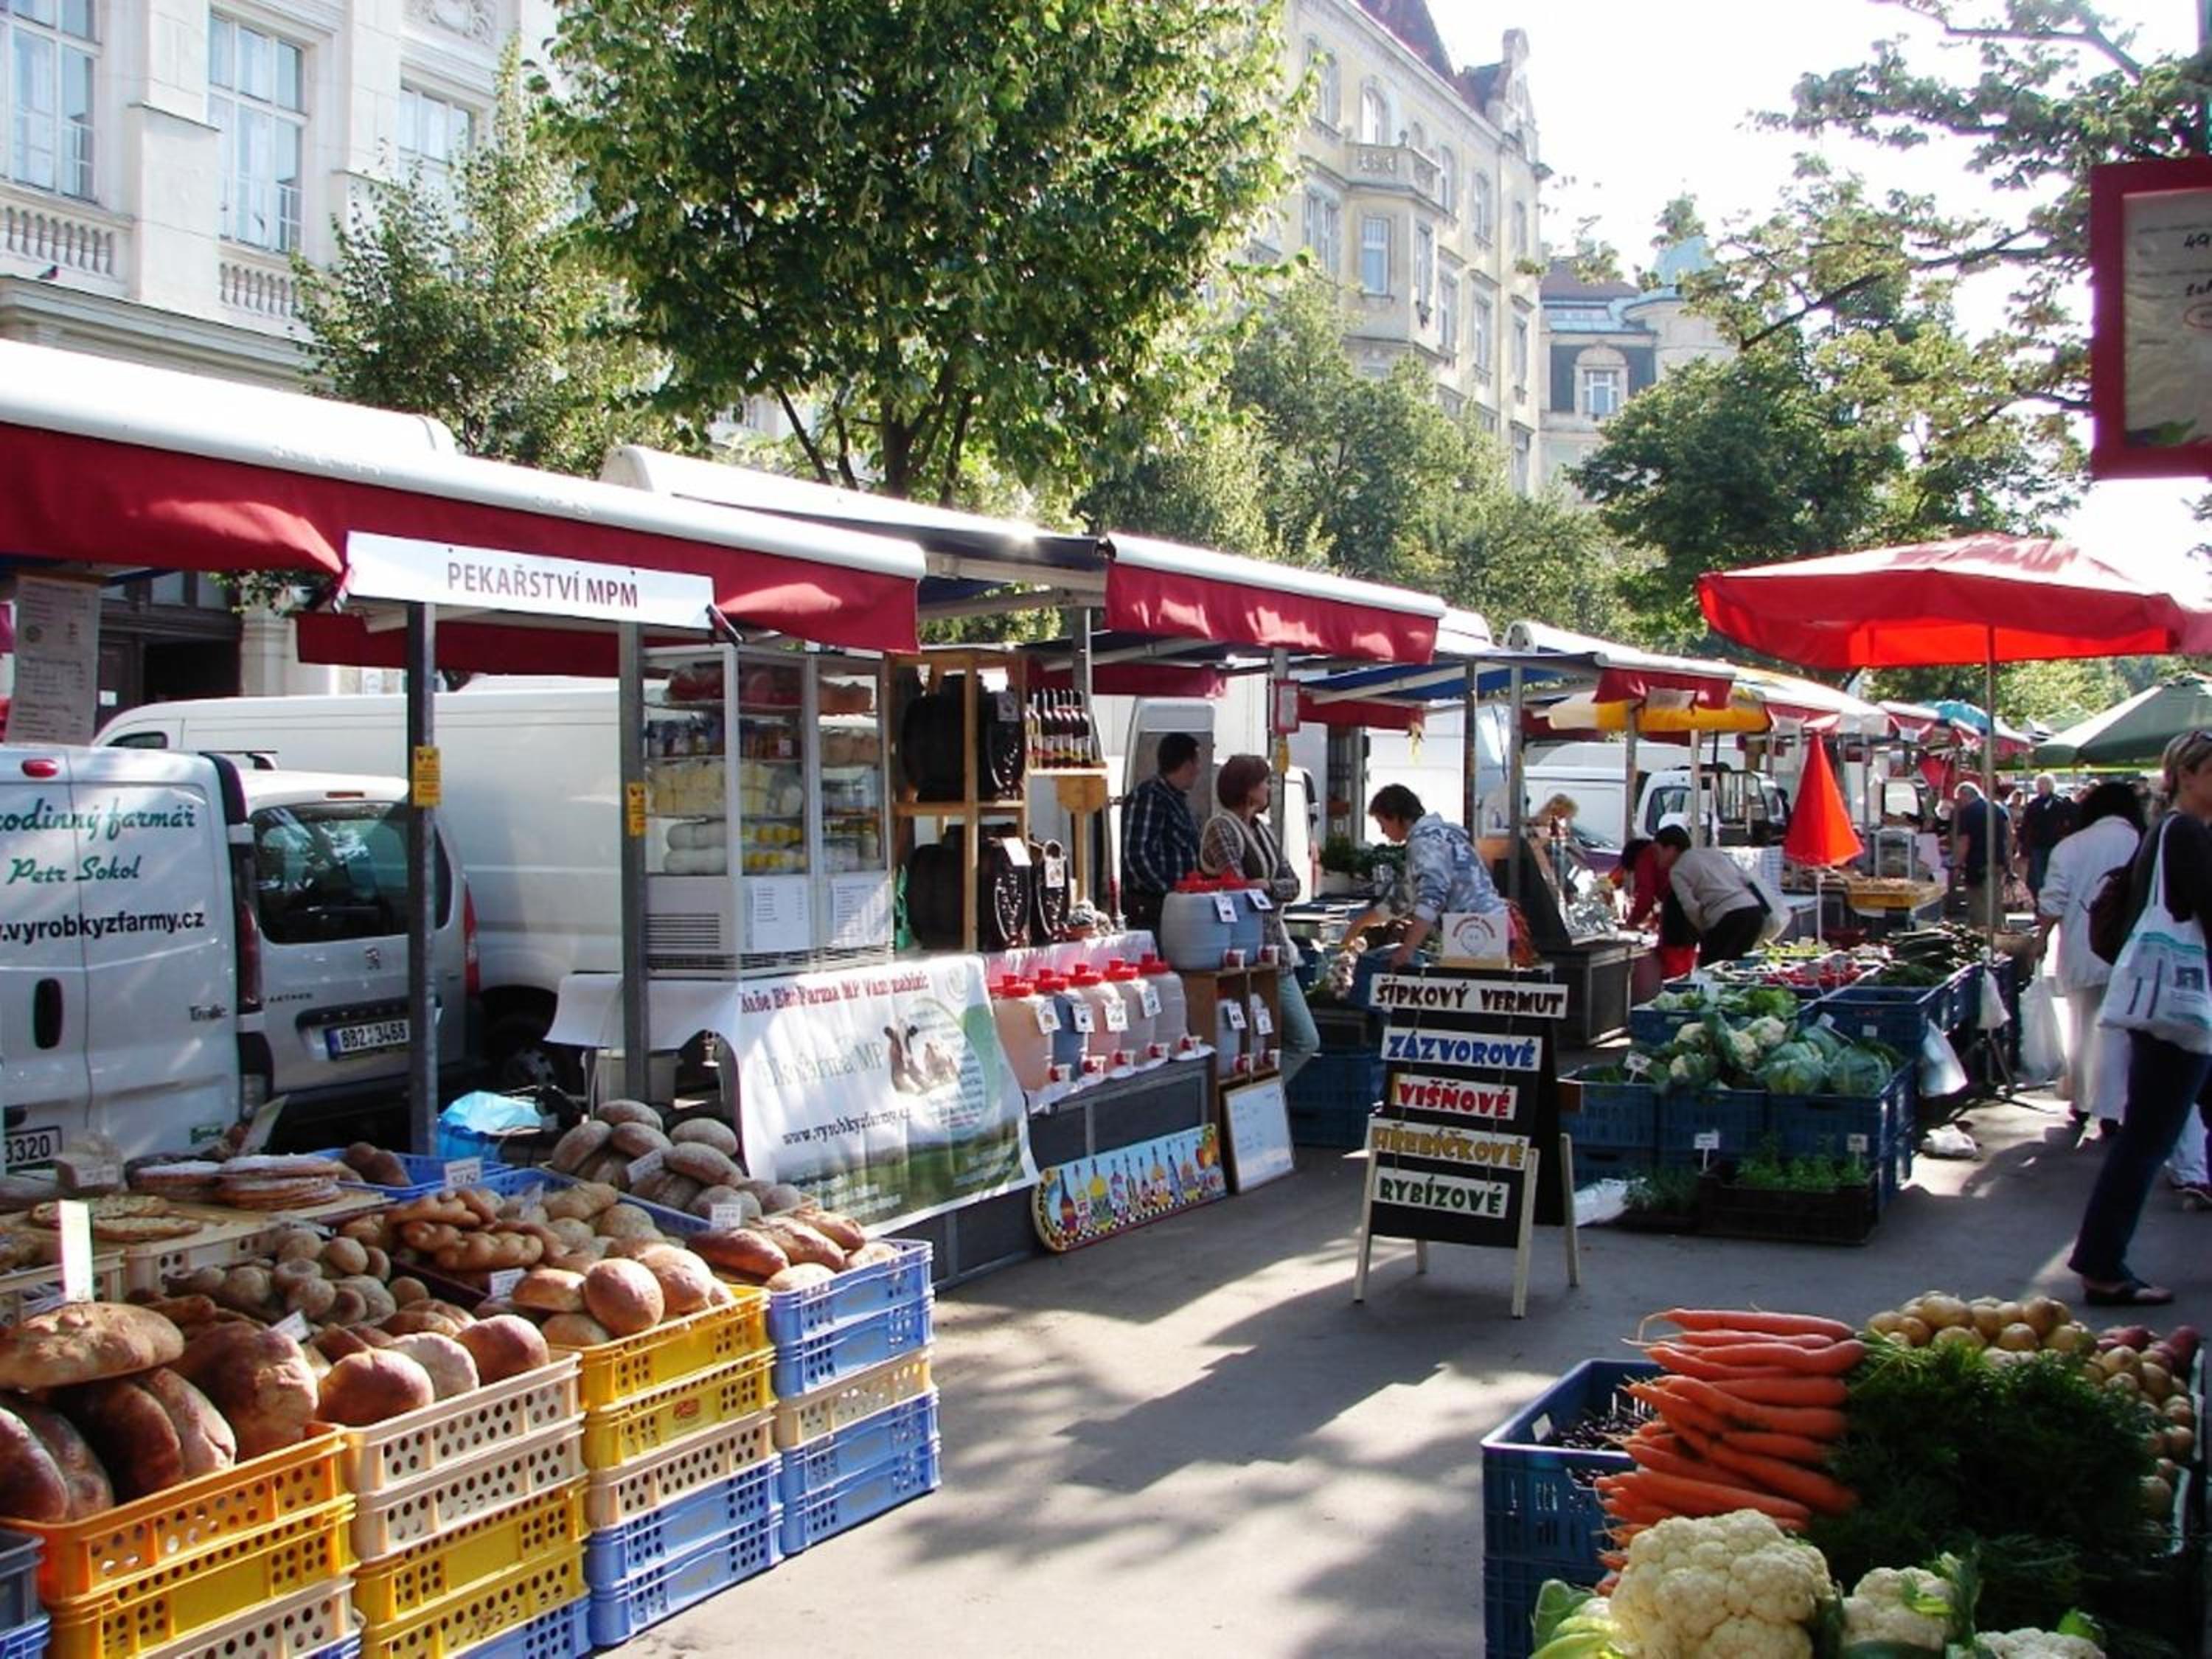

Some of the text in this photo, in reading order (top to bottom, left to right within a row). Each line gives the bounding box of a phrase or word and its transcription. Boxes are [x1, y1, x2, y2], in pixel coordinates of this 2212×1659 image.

[448, 562, 638, 608] PEKAŘSTVÍ MPM
[0, 797, 196, 841] odinný farmář
[7, 855, 142, 884] Petr Sokol
[0, 911, 205, 945] .vyrobkyzfarmy.cz
[1376, 978, 1564, 1015] ŠÍPKOVÝ VERMUT
[1388, 1029, 1536, 1068] ZÁZVOROVÉ
[1399, 1079, 1511, 1116] VIŠŇOVÉ
[1380, 1175, 1503, 1214] RYBÍZOVÉ
